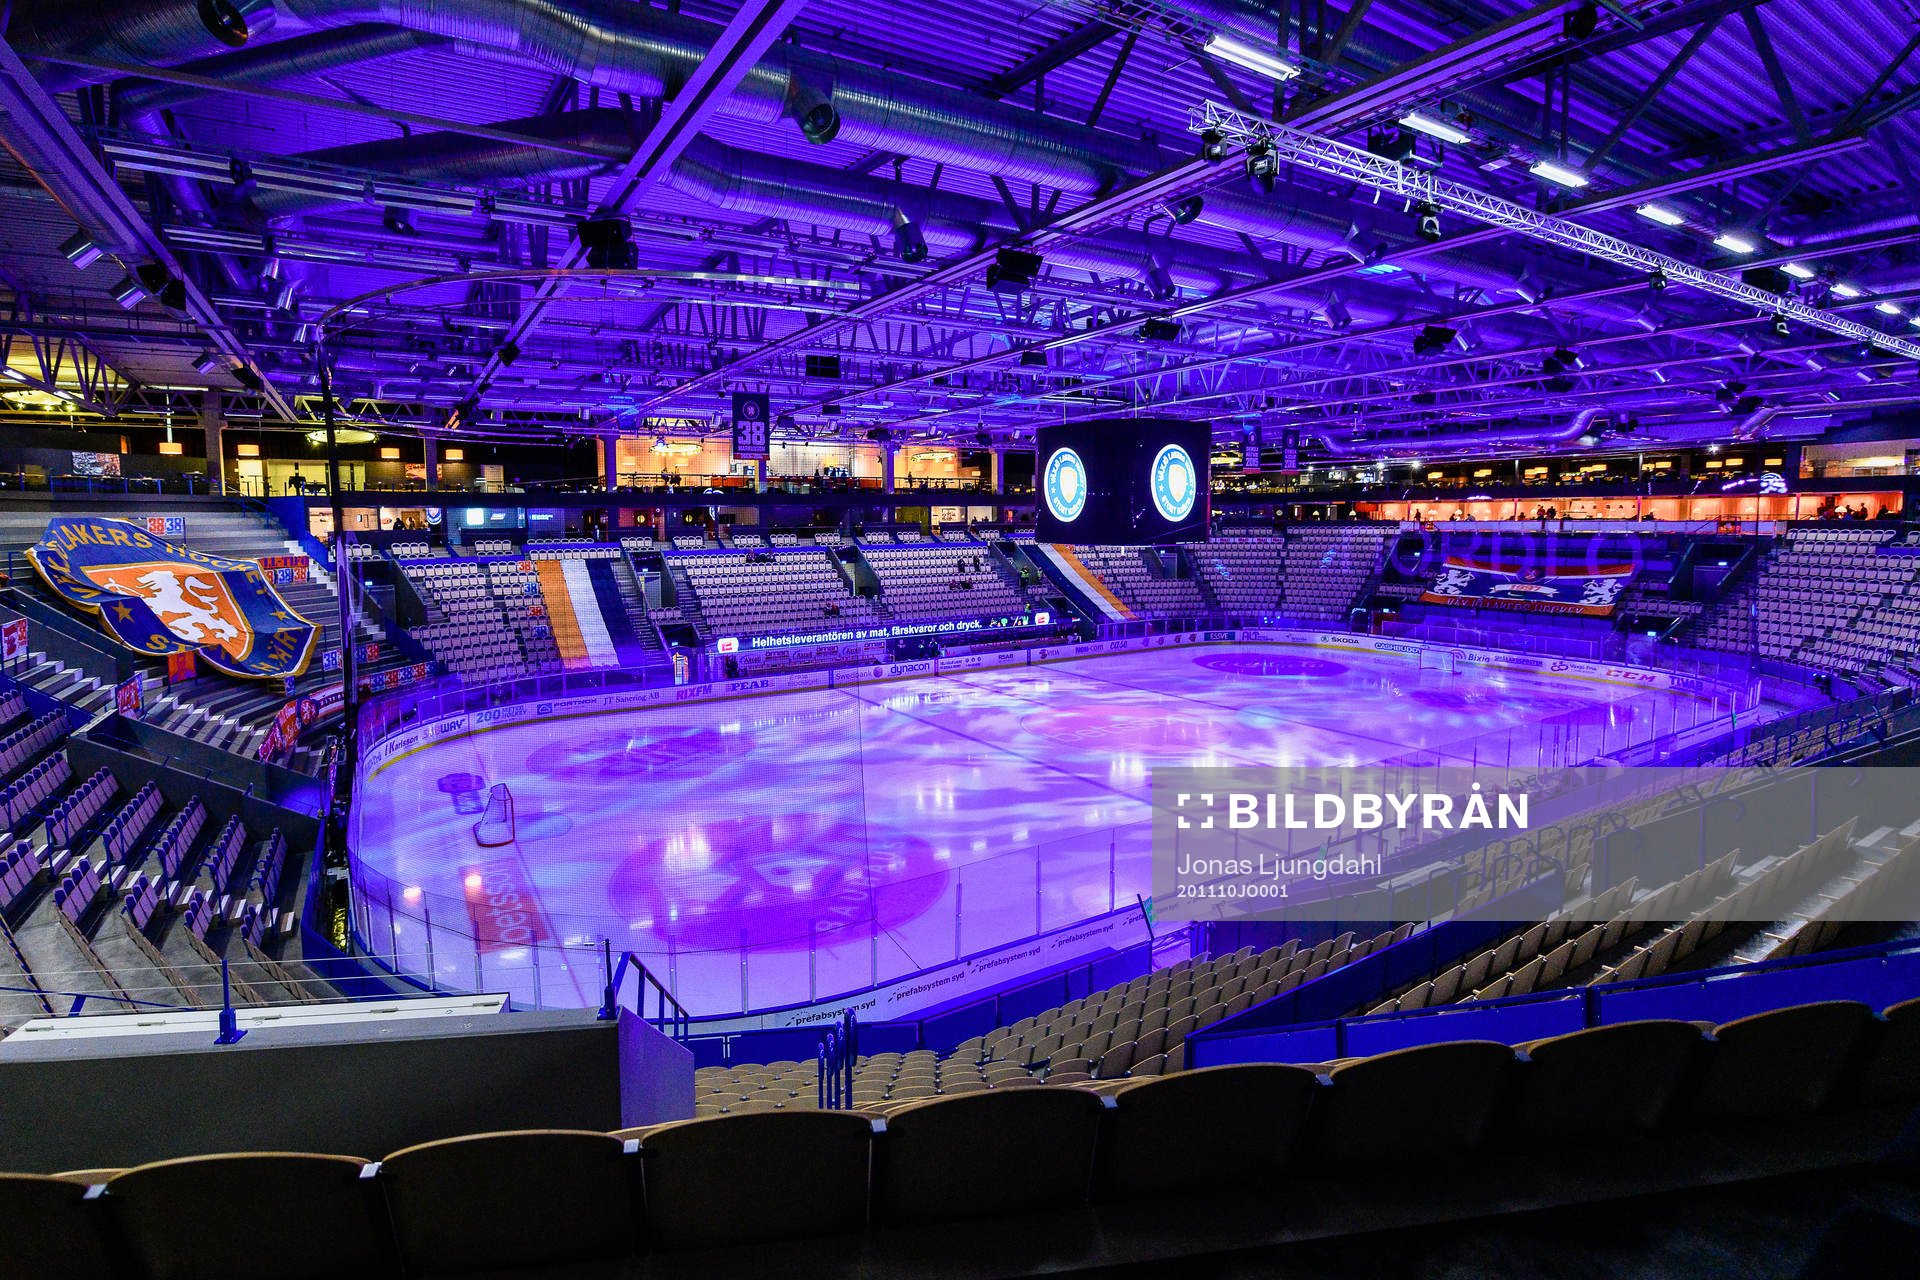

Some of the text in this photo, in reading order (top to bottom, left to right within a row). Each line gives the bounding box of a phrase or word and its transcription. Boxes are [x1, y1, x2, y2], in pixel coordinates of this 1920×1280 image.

[737, 421, 766, 446] 38
[51, 524, 153, 551] LAKERS
[752, 619, 983, 647] Helhetsleverantören av mat, färskvaror och dryck.
[324, 652, 338, 668] 38
[890, 662, 930, 675] dynacon
[730, 680, 770, 692] PEAB
[476, 710, 500, 724] 200
[1058, 924, 1114, 948] prefabsystem syd
[979, 946, 1041, 972] prefabsystem syd
[896, 971, 965, 1001] prefabsystem syd
[795, 999, 877, 1026] prefabsystm syd
